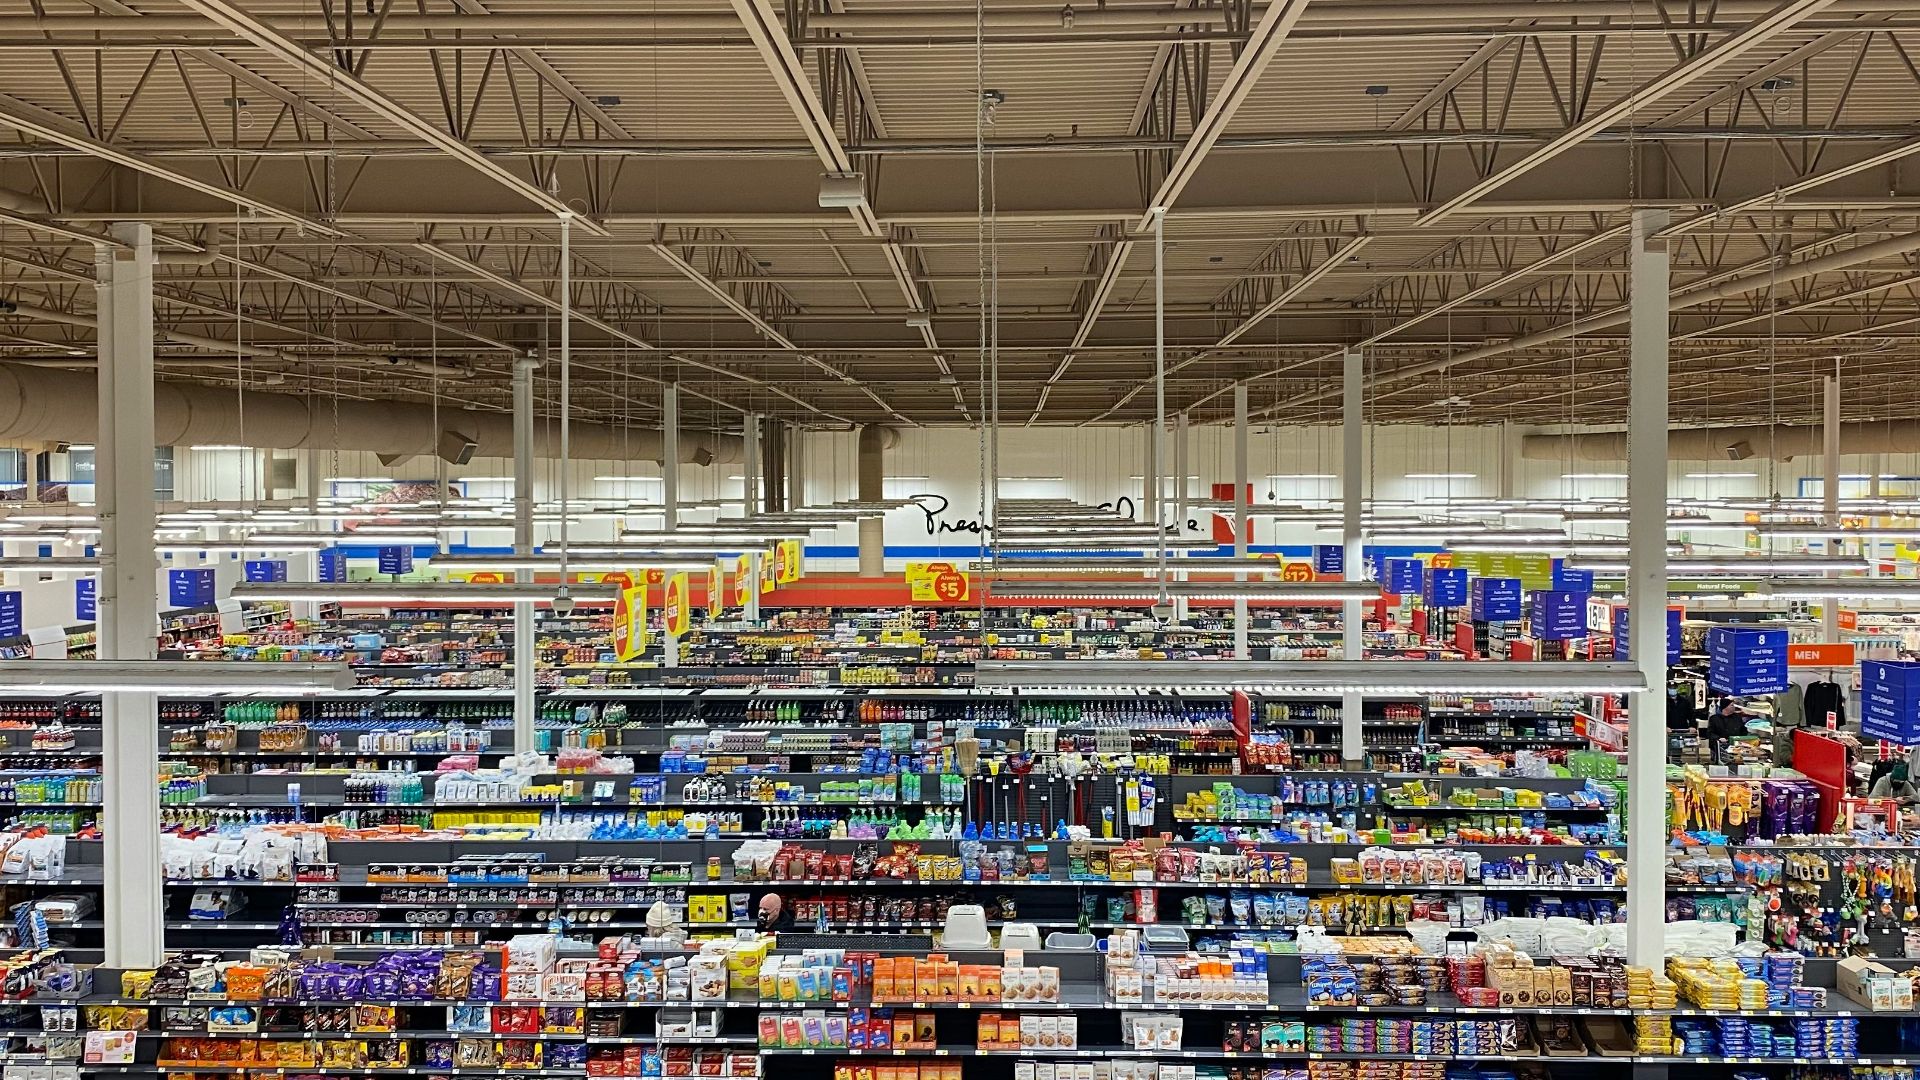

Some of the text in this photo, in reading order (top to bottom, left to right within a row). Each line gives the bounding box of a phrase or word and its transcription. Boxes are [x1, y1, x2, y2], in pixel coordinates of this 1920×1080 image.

[1500, 580, 1506, 588] 5
[940, 582, 959, 598] $5
[1564, 594, 1570, 602] 6
[616, 626, 628, 641] SIZE
[1720, 633, 1725, 644] 8
[1758, 634, 1766, 645] 8
[1794, 650, 1820, 660] MEN
[1880, 668, 1886, 680] 9
